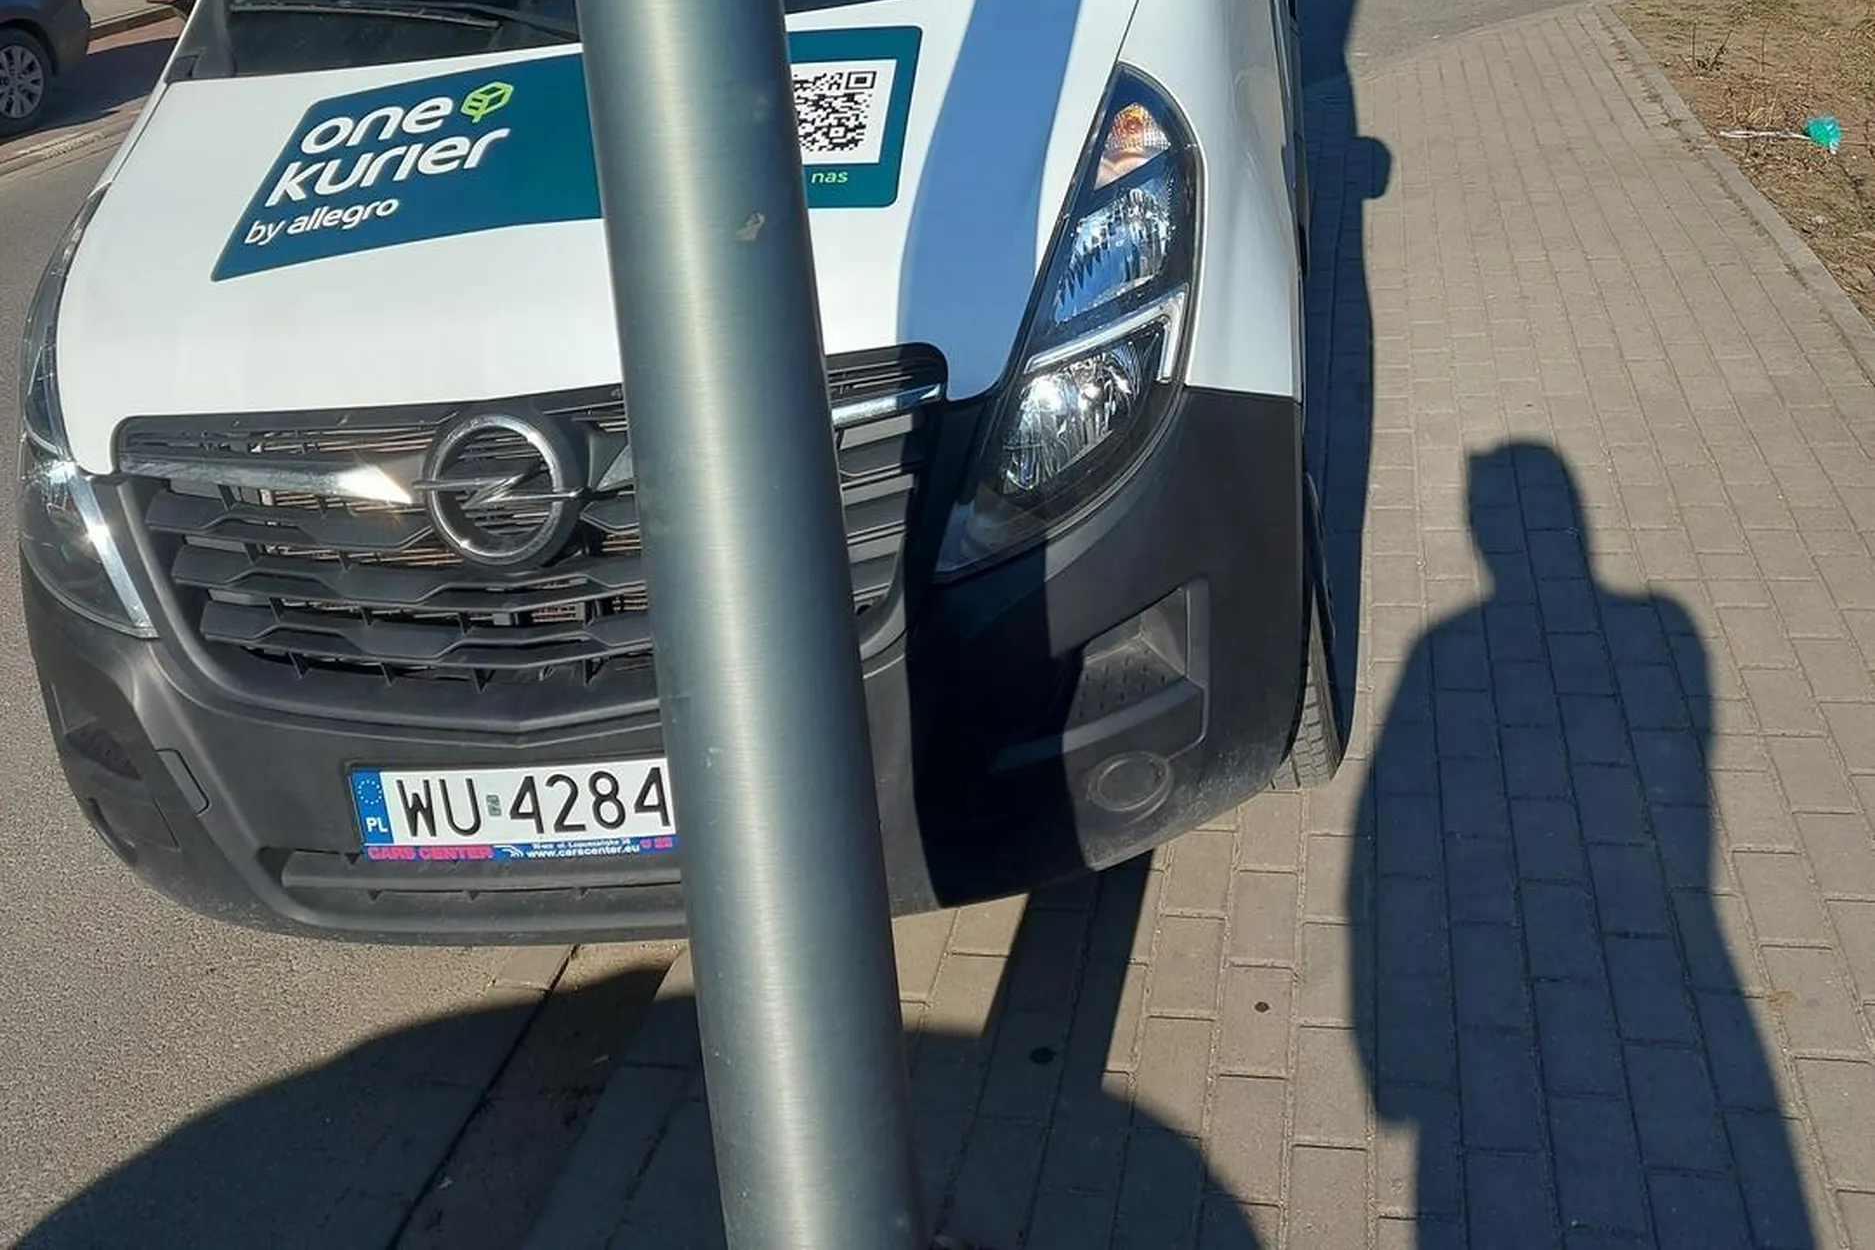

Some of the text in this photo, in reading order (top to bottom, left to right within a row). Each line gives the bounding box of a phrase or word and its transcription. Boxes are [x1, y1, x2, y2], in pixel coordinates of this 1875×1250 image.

[300, 92, 453, 155] one
[265, 127, 511, 209] kurier
[810, 170, 848, 184] nas
[244, 196, 399, 246] by allegro
[395, 766, 671, 838] WU 4284
[365, 816, 388, 833] PL
[367, 844, 493, 860] CARS CENTER
[526, 844, 640, 859] www.carscenter.eu
